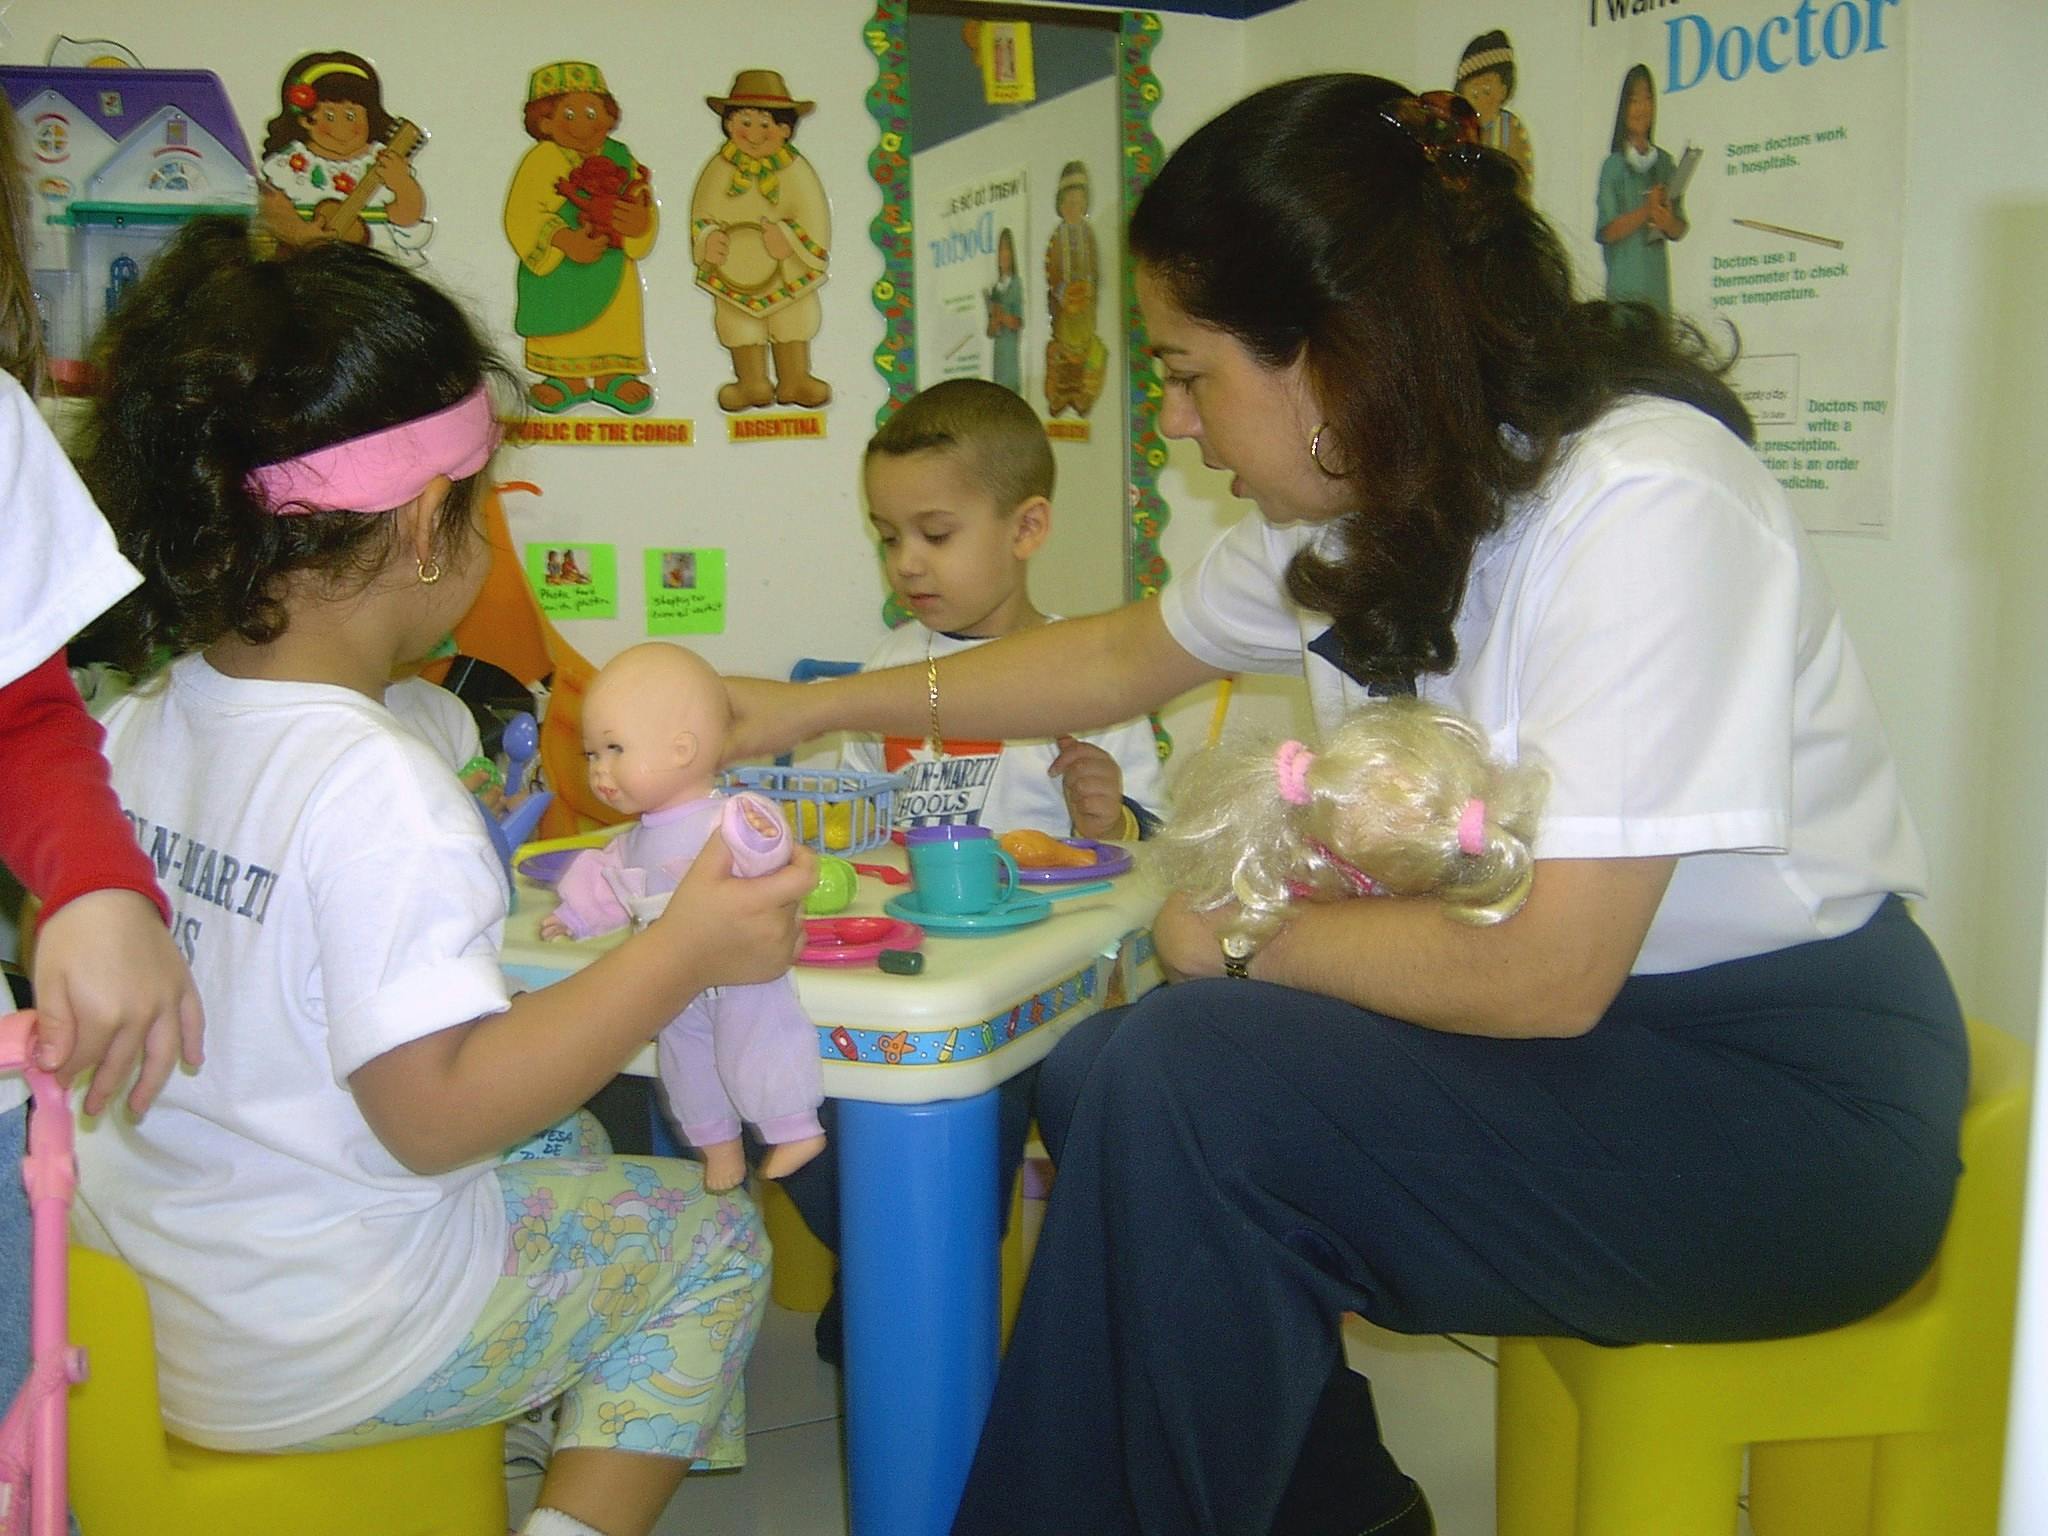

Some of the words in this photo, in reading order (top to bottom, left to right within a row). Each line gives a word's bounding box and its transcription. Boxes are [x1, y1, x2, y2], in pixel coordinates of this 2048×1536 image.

[1664, 0, 1899, 94] Doctor
[1727, 143, 1761, 158] Some
[1764, 134, 1811, 152] doctors
[1816, 125, 1848, 143] work
[1741, 154, 1801, 175] hospitals.
[1713, 256, 1760, 270] Doctors
[1763, 253, 1785, 265] use
[1712, 271, 1790, 288] thermometer
[1794, 268, 1807, 281] to
[1809, 263, 1848, 279] check
[1711, 295, 1738, 309] your
[1742, 288, 1820, 306] temperature.
[1808, 400, 1858, 413] Doctors
[1862, 401, 1888, 415] may
[575, 422, 595, 441] OF
[598, 423, 628, 442] THE
[632, 424, 688, 444] CONGO
[735, 416, 820, 438] ARGENTINA
[1808, 418, 1839, 432] write
[1844, 421, 1853, 432] a
[1764, 439, 1841, 454] prescription.
[1793, 457, 1803, 470] is
[1807, 459, 1824, 470] an
[1825, 457, 1860, 470] order
[1777, 476, 1830, 490] edicine.
